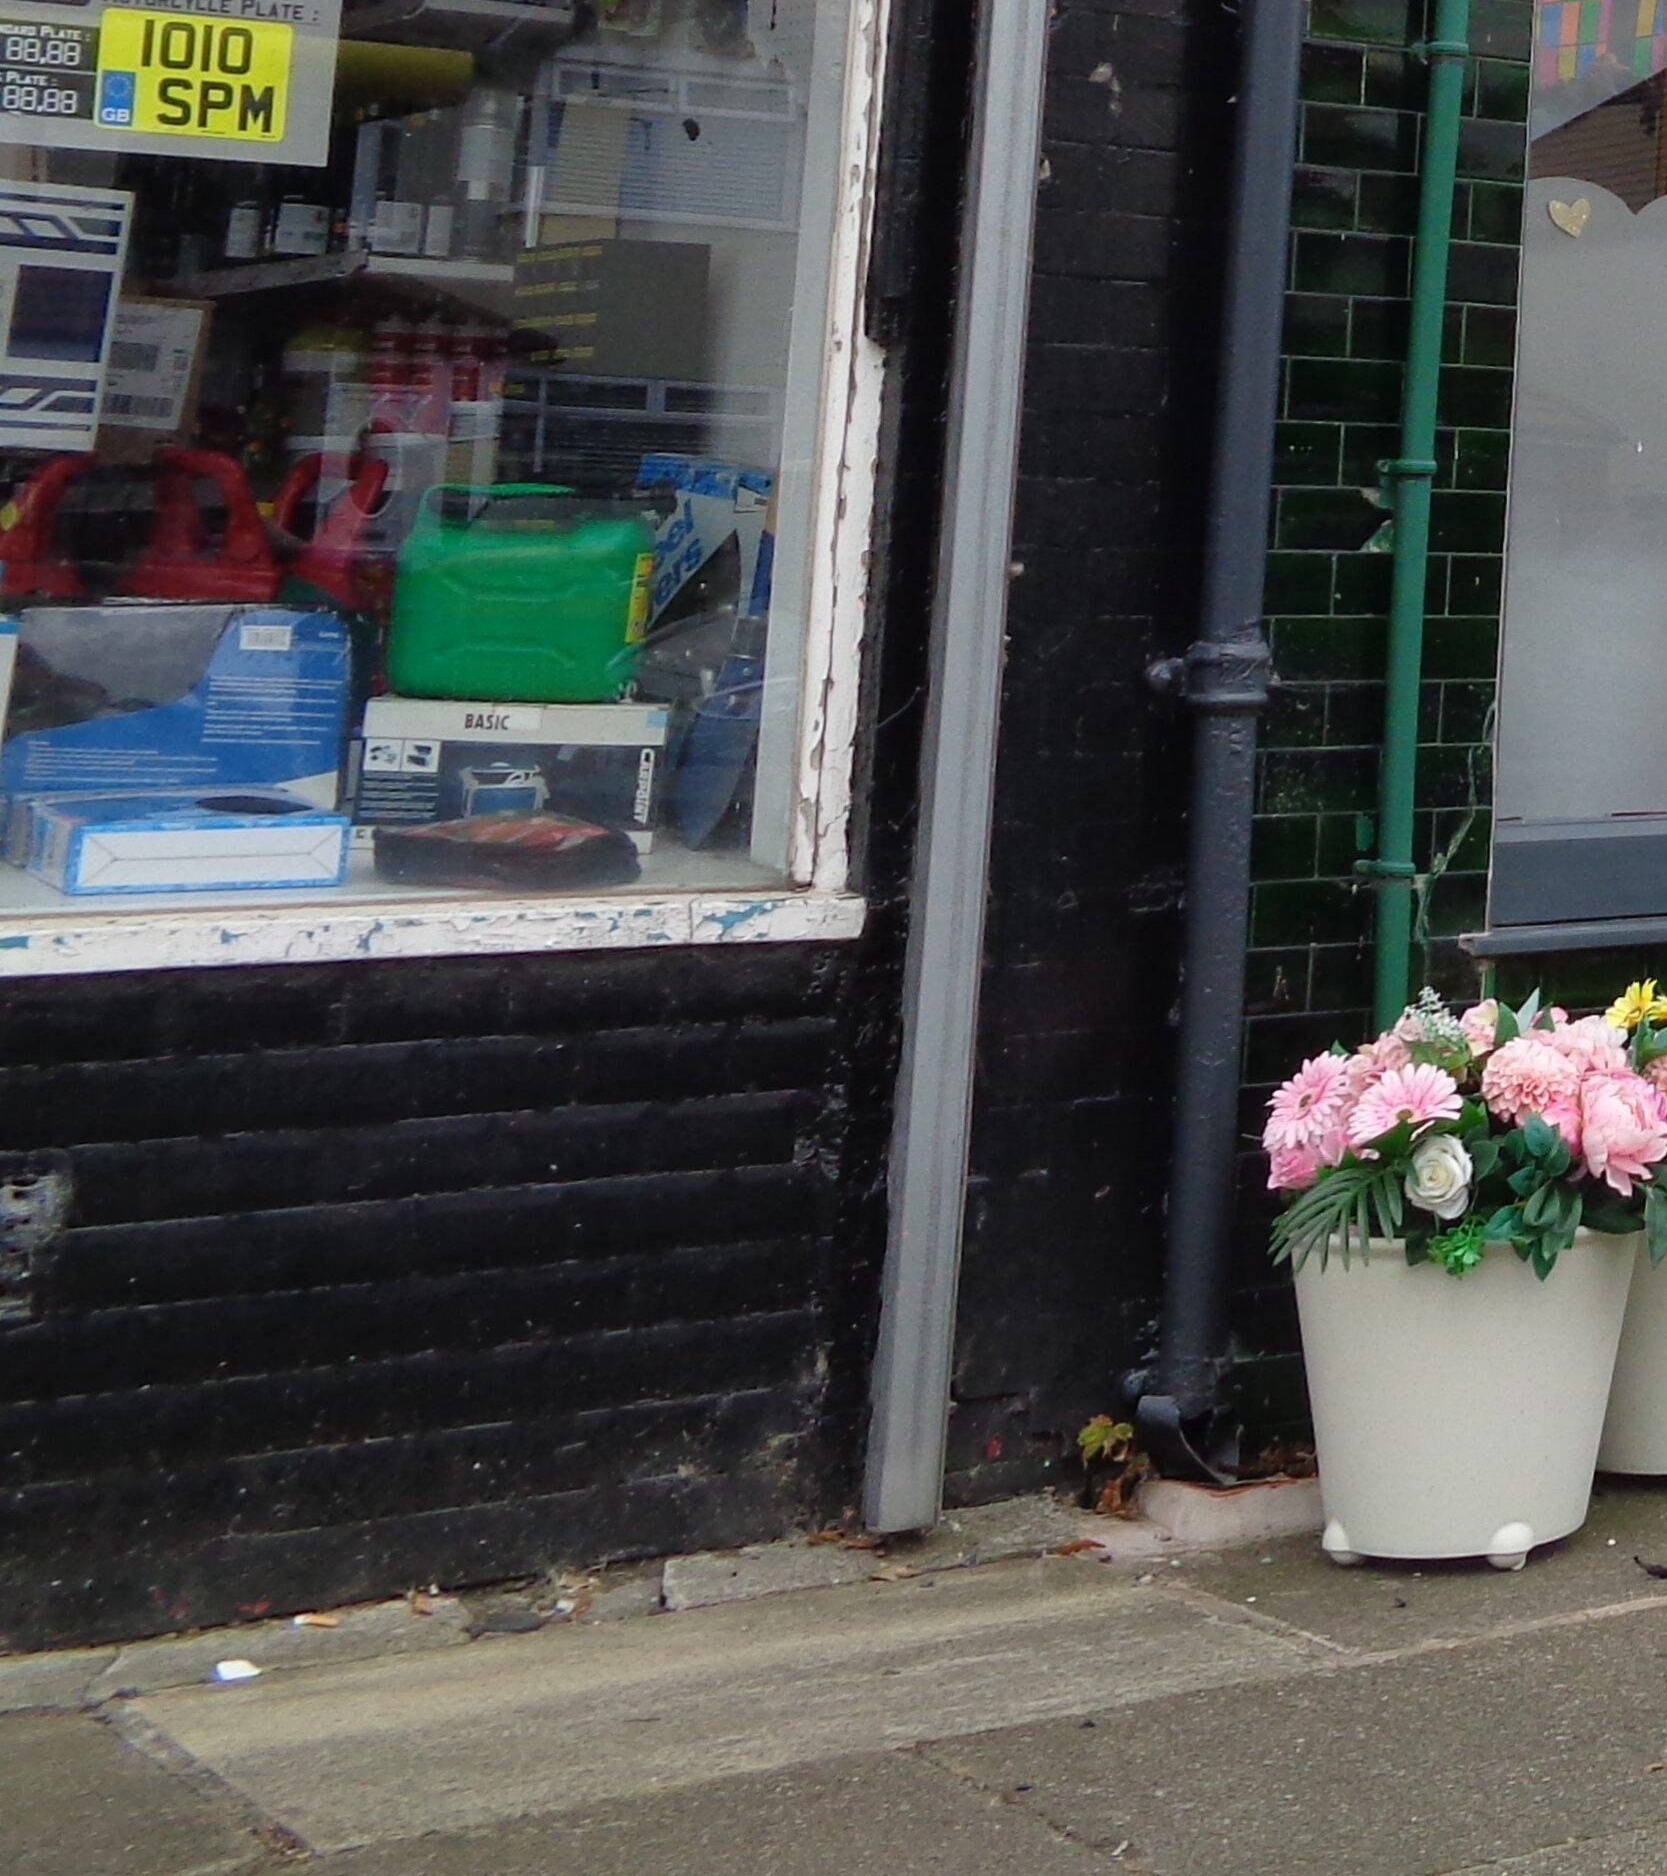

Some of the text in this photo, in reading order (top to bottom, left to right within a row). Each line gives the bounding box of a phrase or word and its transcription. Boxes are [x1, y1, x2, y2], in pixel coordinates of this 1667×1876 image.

[141, 18, 253, 75] 1010
[102, 108, 129, 122] GB
[157, 77, 274, 133] SPM
[464, 714, 510, 730] BASIC
